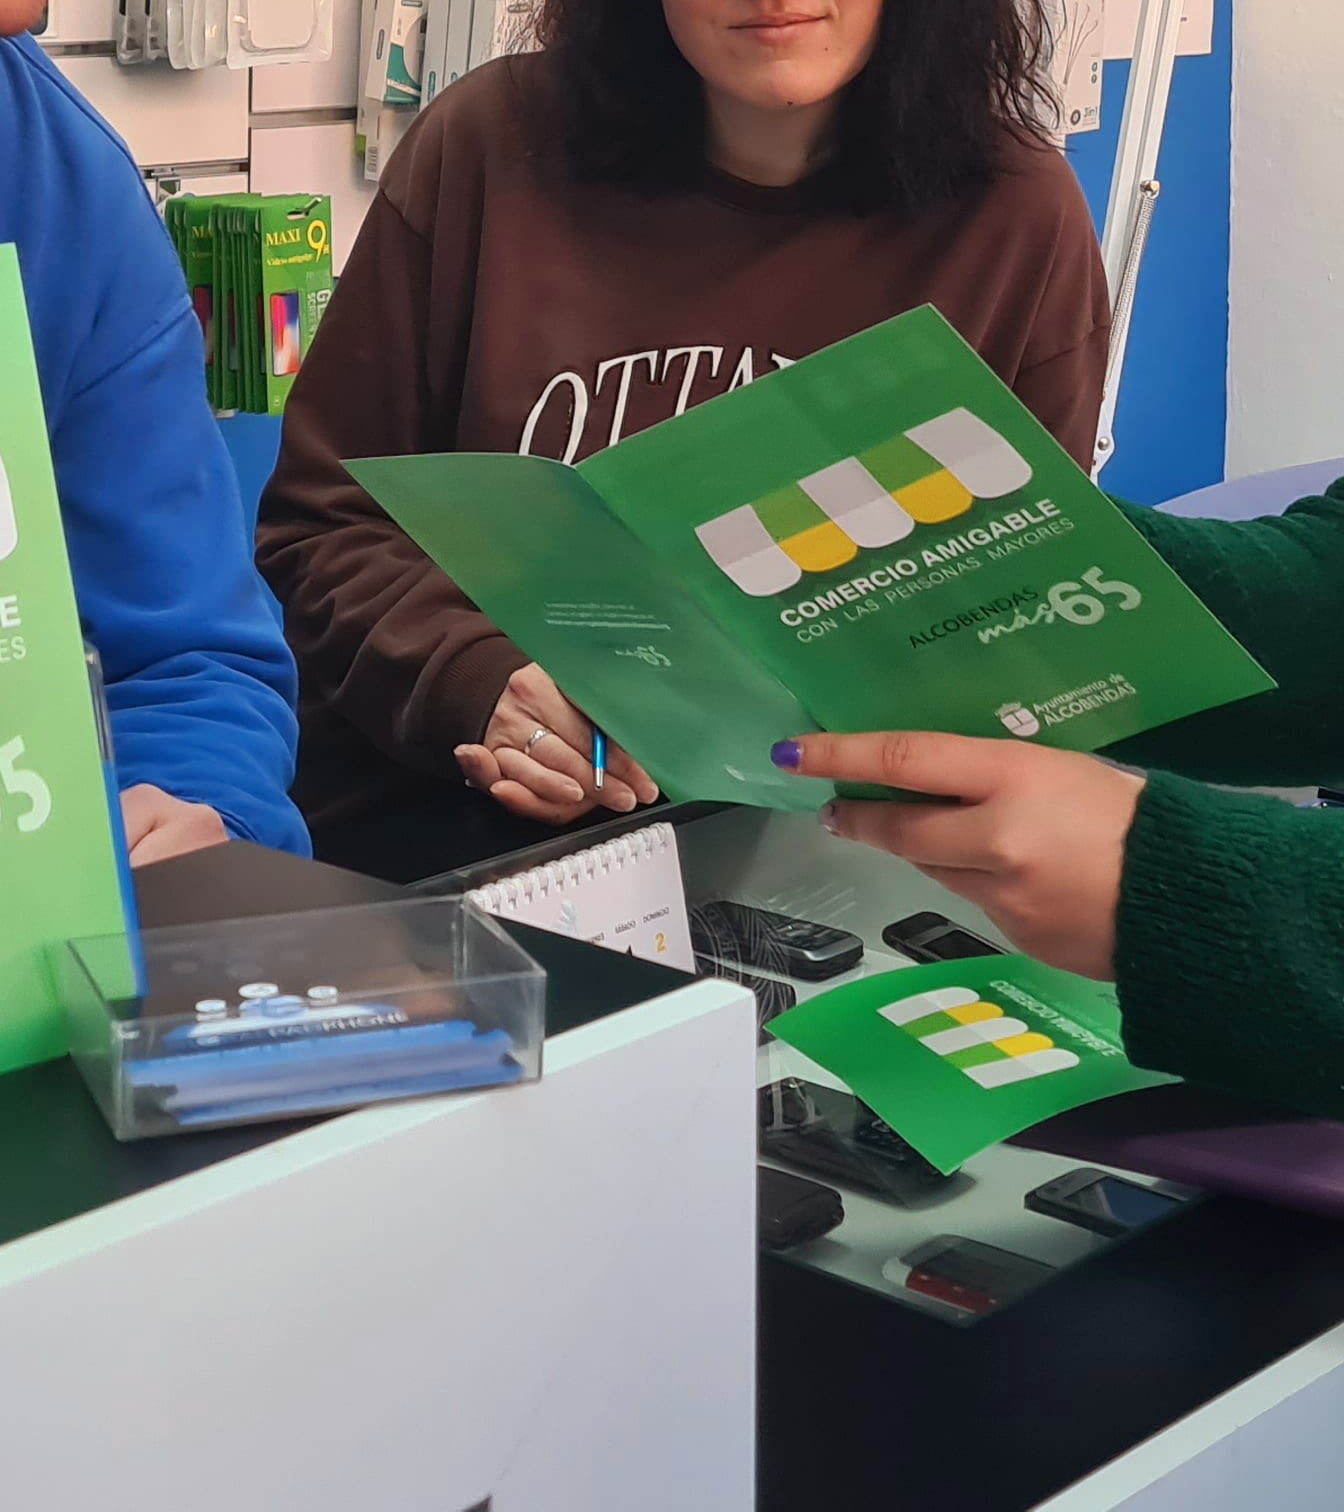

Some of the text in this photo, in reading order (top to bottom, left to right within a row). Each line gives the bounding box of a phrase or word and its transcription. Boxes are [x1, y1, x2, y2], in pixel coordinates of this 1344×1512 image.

[266, 228, 300, 246] MAXI
[780, 498, 1061, 626] COMERCIO AMIGABLE
[796, 517, 1075, 643] CON LAS PERSONAS MAYORES
[908, 589, 1039, 649] ALCOBENDAS
[1033, 680, 1107, 715] Ayuntamiento
[1044, 683, 1136, 726] ALCOBENDAS
[656, 932, 666, 953] 2
